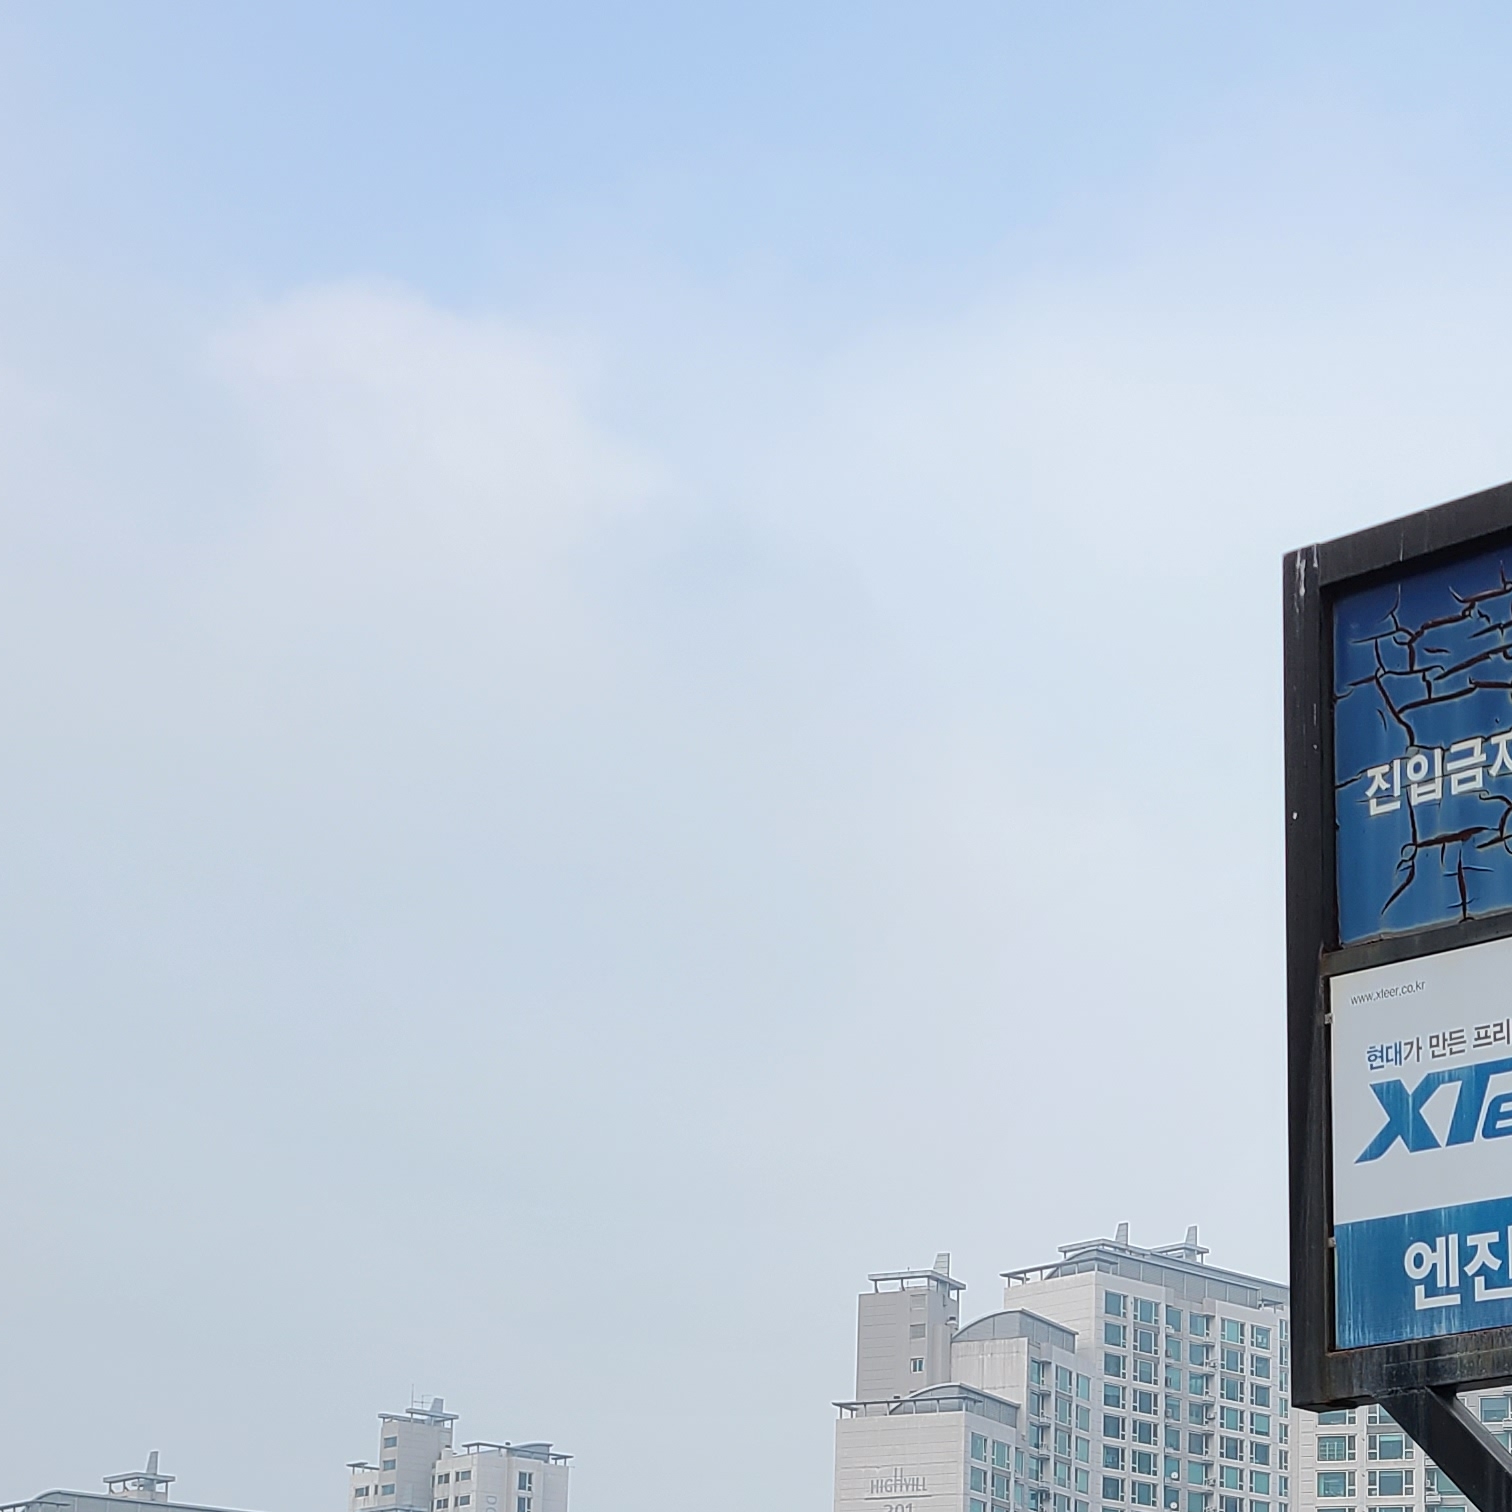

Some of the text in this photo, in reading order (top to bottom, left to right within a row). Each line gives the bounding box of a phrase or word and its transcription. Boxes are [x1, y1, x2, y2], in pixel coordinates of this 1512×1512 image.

[1367, 1040, 1422, 1071] 현대가
[1429, 1029, 1467, 1058] 만든
[870, 1467, 928, 1494] HIGHVILL
